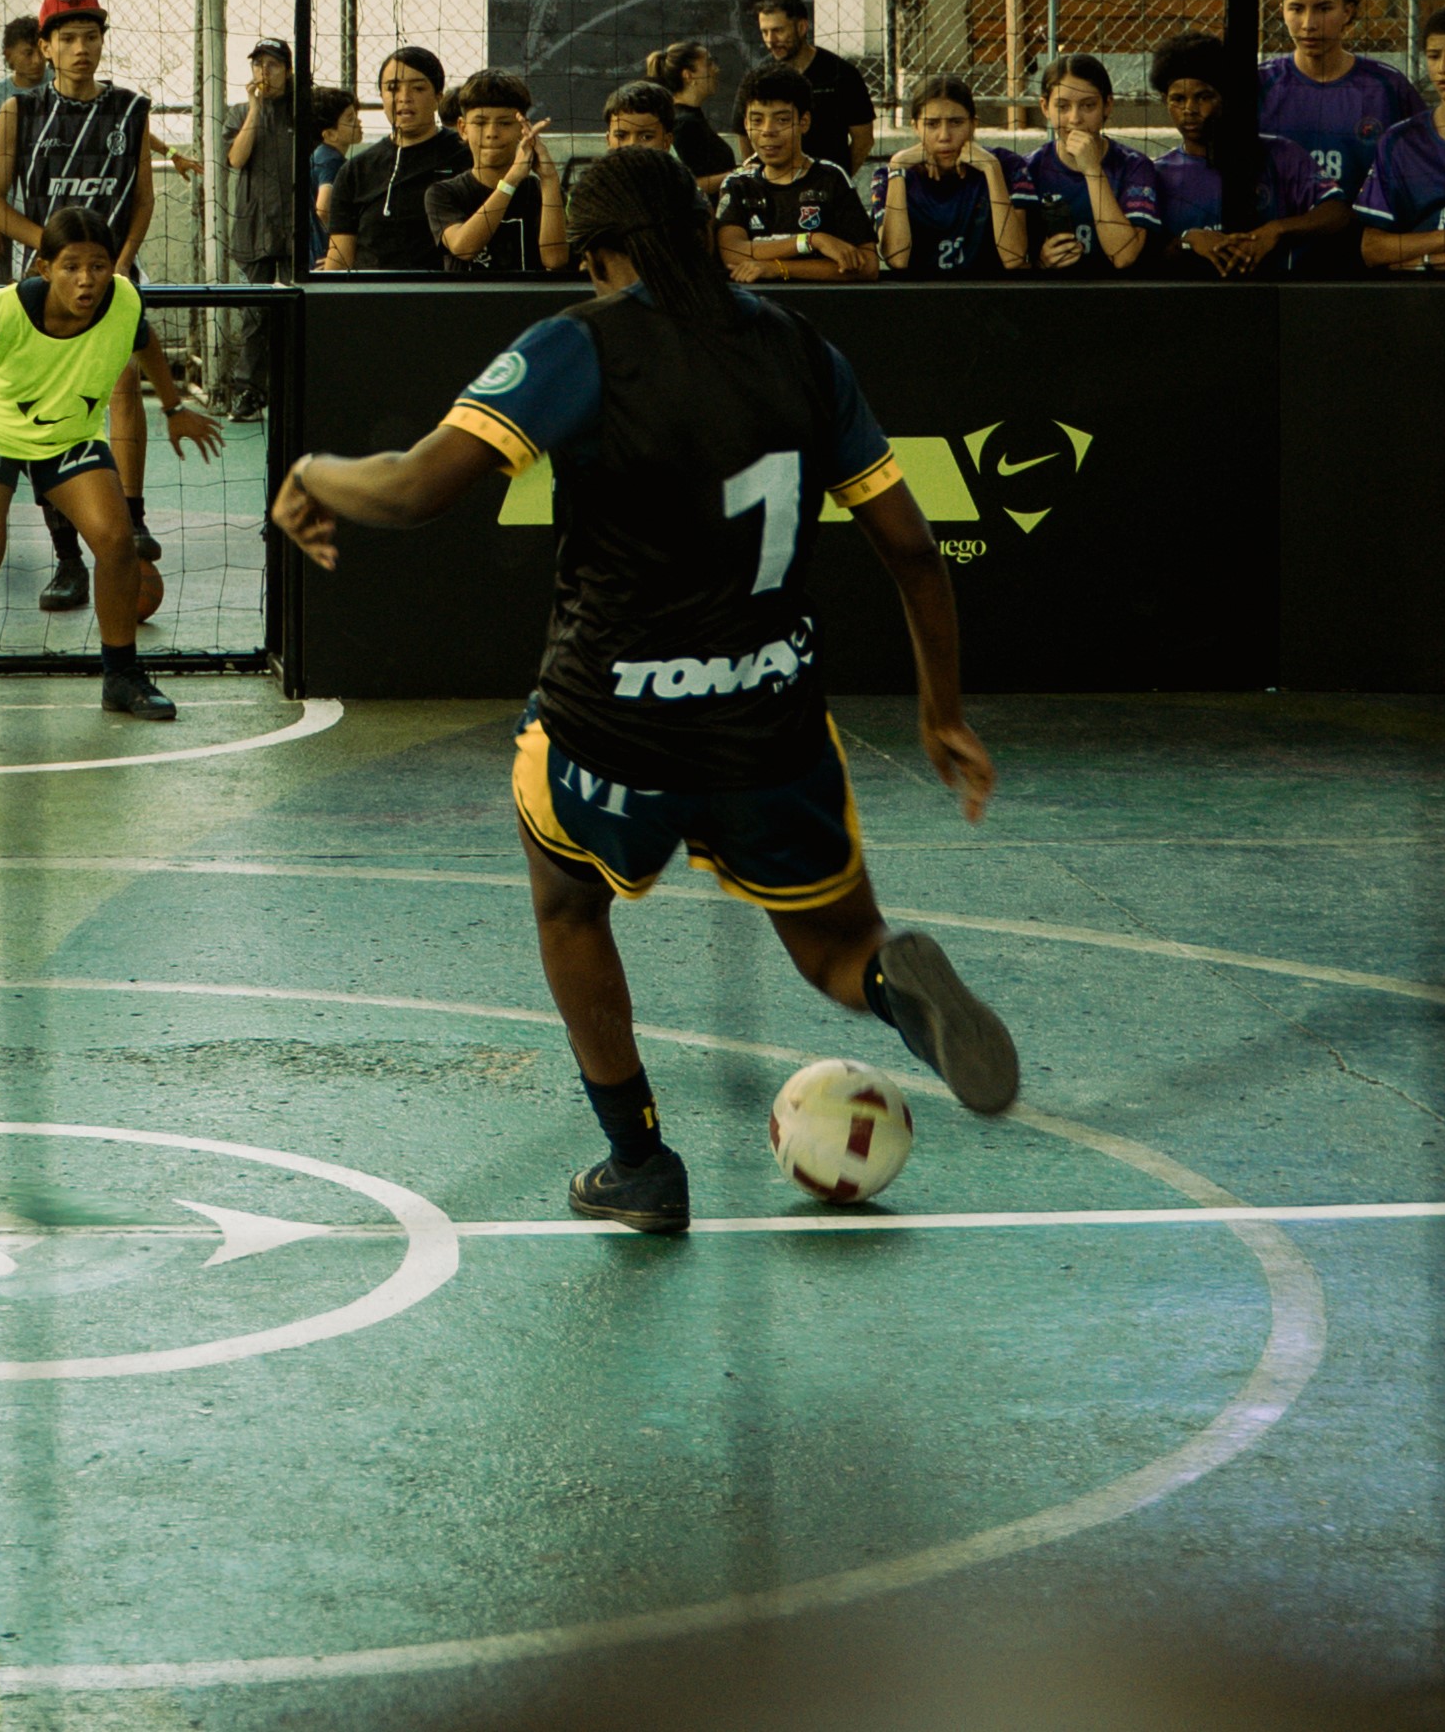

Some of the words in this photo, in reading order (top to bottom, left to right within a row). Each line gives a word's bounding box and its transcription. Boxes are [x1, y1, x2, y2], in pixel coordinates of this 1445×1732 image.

[47, 177, 118, 197] MCR
[722, 451, 801, 596] 1
[612, 639, 799, 699] TOMA
